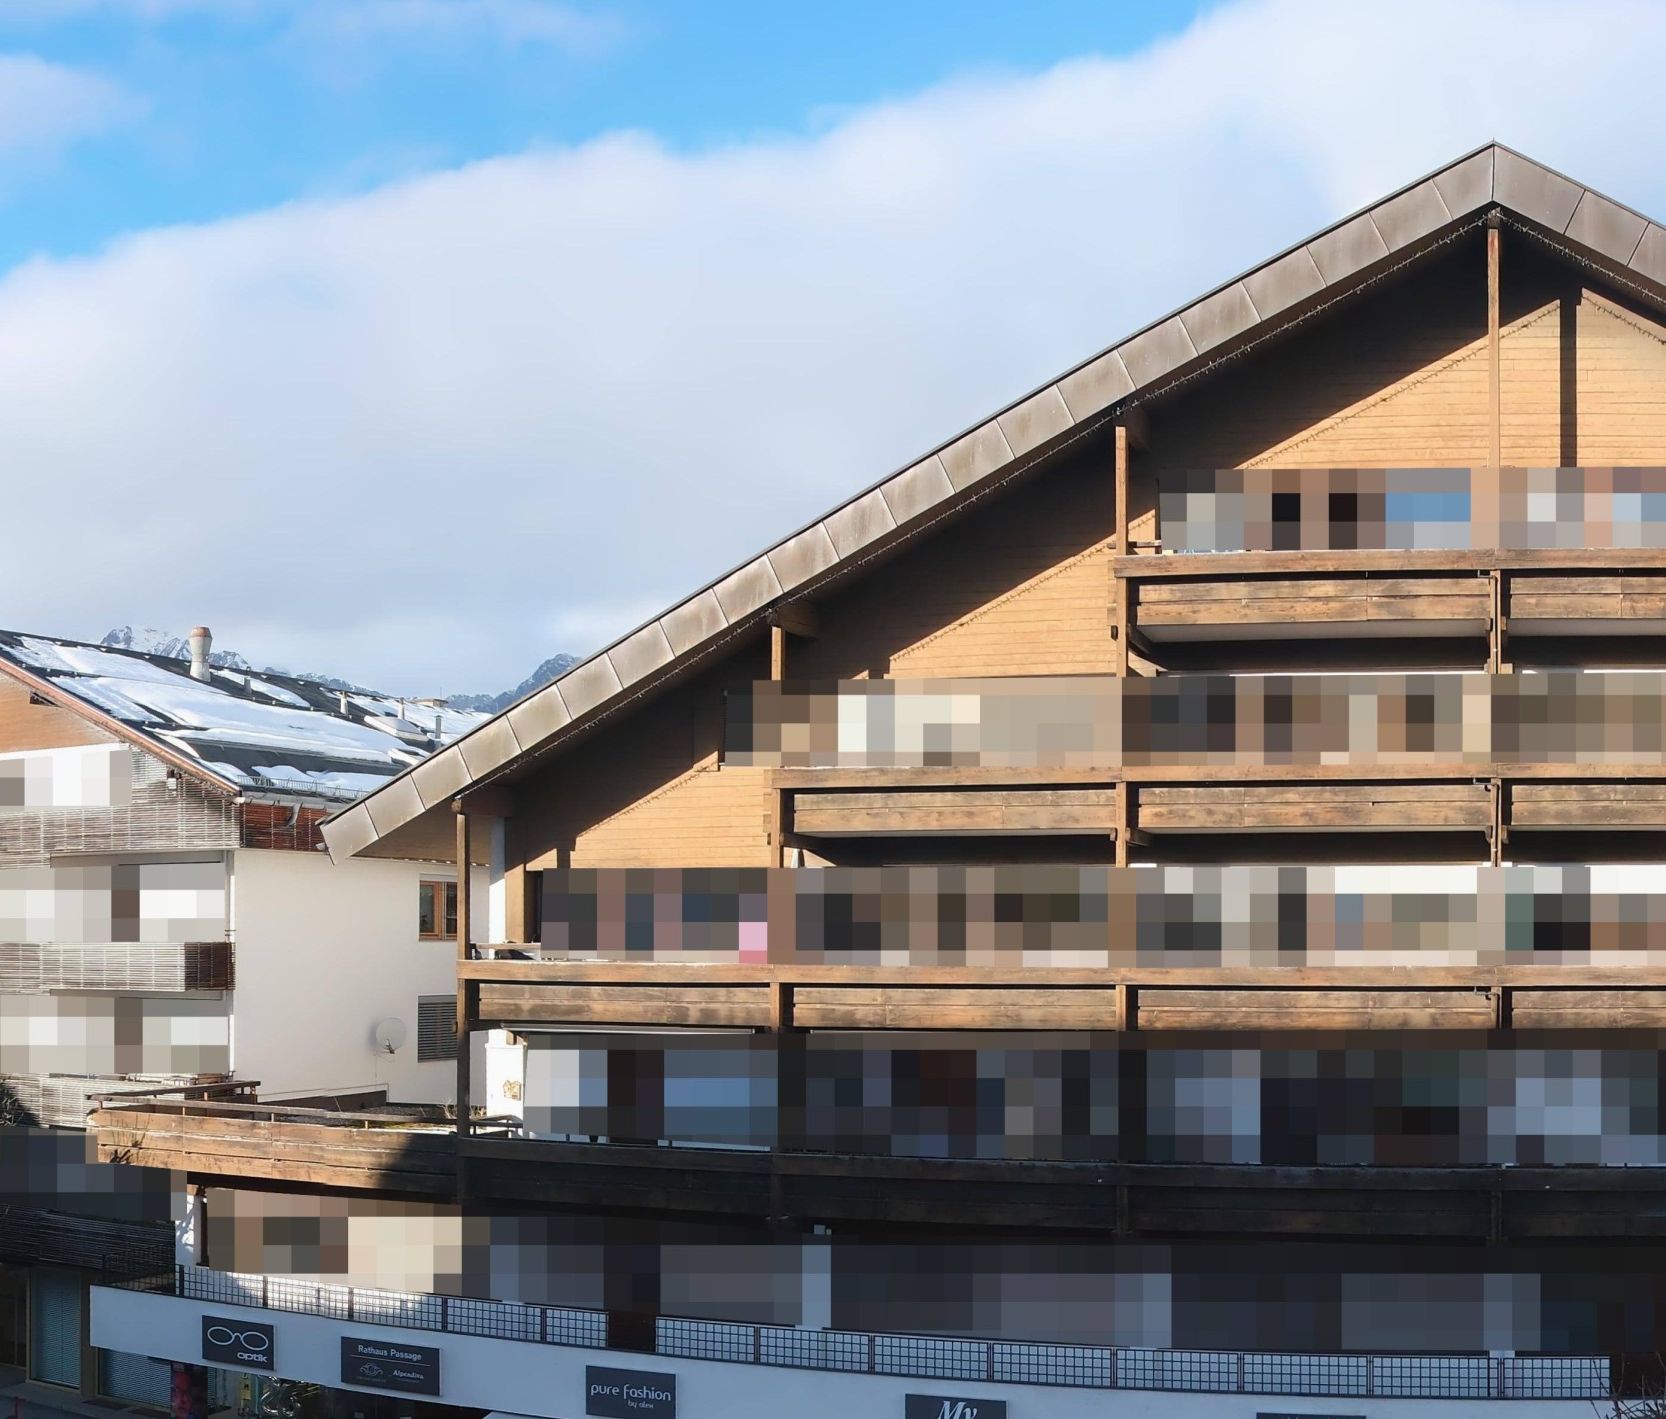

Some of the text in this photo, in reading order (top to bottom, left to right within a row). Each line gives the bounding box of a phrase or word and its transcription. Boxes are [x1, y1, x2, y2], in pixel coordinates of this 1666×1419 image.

[237, 1352, 268, 1363] optik
[358, 1344, 422, 1361] Rathaus Passage
[591, 1383, 671, 1401] pure fashion
[627, 1399, 637, 1409] by
